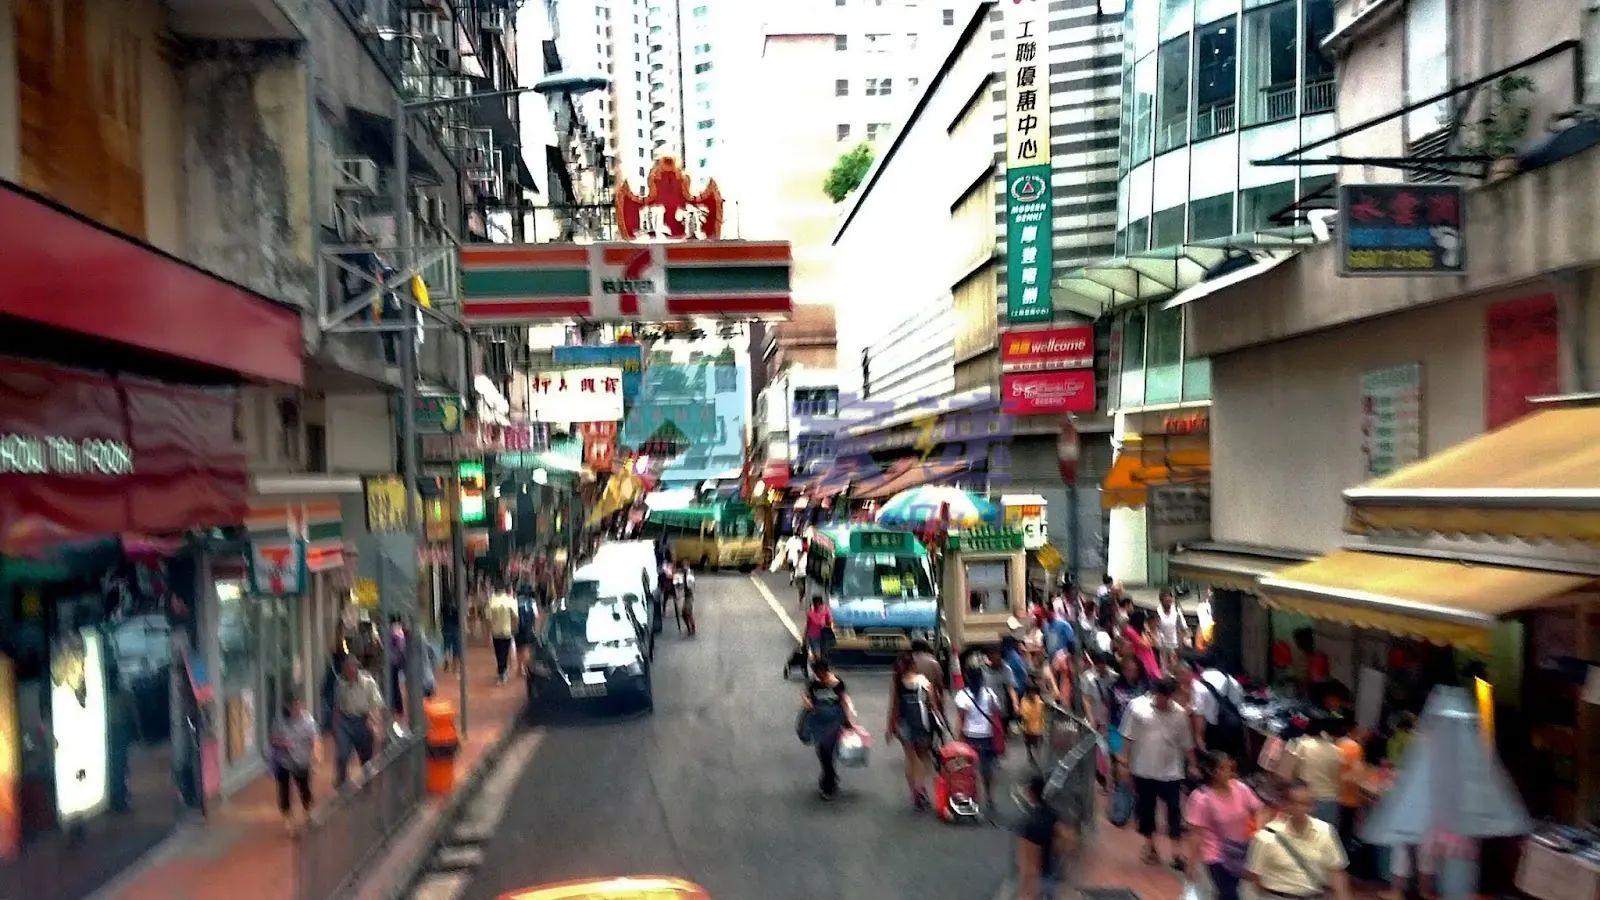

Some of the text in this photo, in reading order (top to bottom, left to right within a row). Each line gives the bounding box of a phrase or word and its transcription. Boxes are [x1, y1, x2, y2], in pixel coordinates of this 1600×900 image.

[1015, 19, 1038, 160] 工聯優惠中心
[1031, 338, 1087, 354] wellcome
